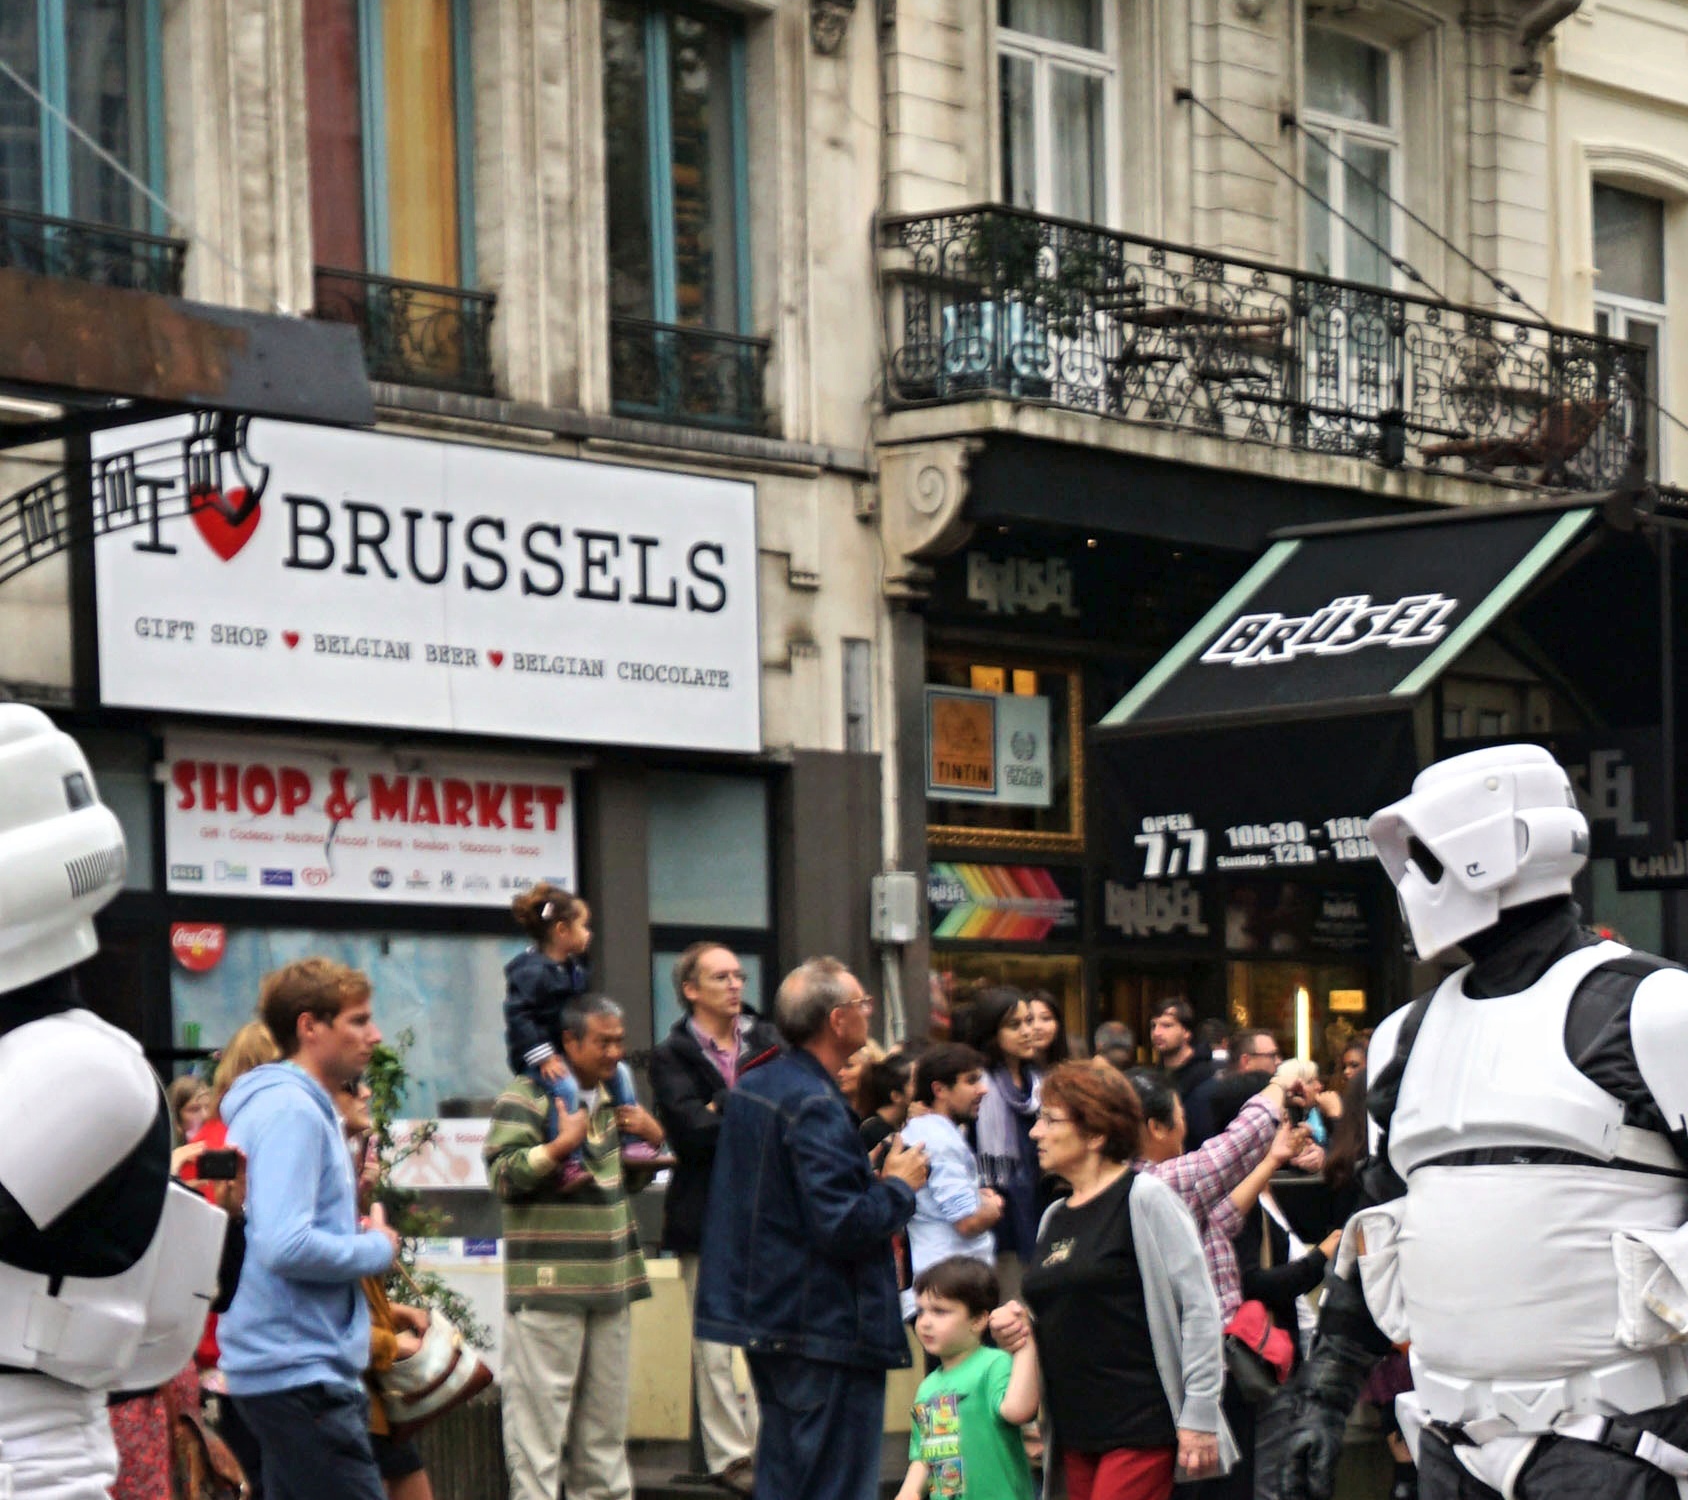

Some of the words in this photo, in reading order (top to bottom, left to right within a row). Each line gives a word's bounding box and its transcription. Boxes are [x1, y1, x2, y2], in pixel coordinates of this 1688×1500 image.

[133, 475, 177, 555] I
[281, 492, 728, 614] BRUSSELS
[134, 616, 195, 642] GIFT
[210, 623, 269, 648] SHOP
[313, 633, 412, 661] BELGIAN
[425, 644, 478, 668] BEER
[512, 652, 605, 679] BELGIAN
[616, 661, 731, 689] CHOCOLATE
[1200, 593, 1459, 668] BRÜSEL
[172, 760, 312, 817] SHOP
[323, 767, 358, 823] &
[368, 772, 565, 833] MARKET
[937, 761, 988, 782] TINTIN
[1141, 814, 1194, 833] OPEN
[1224, 819, 1308, 848] 10h30
[1271, 842, 1316, 864] 12h
